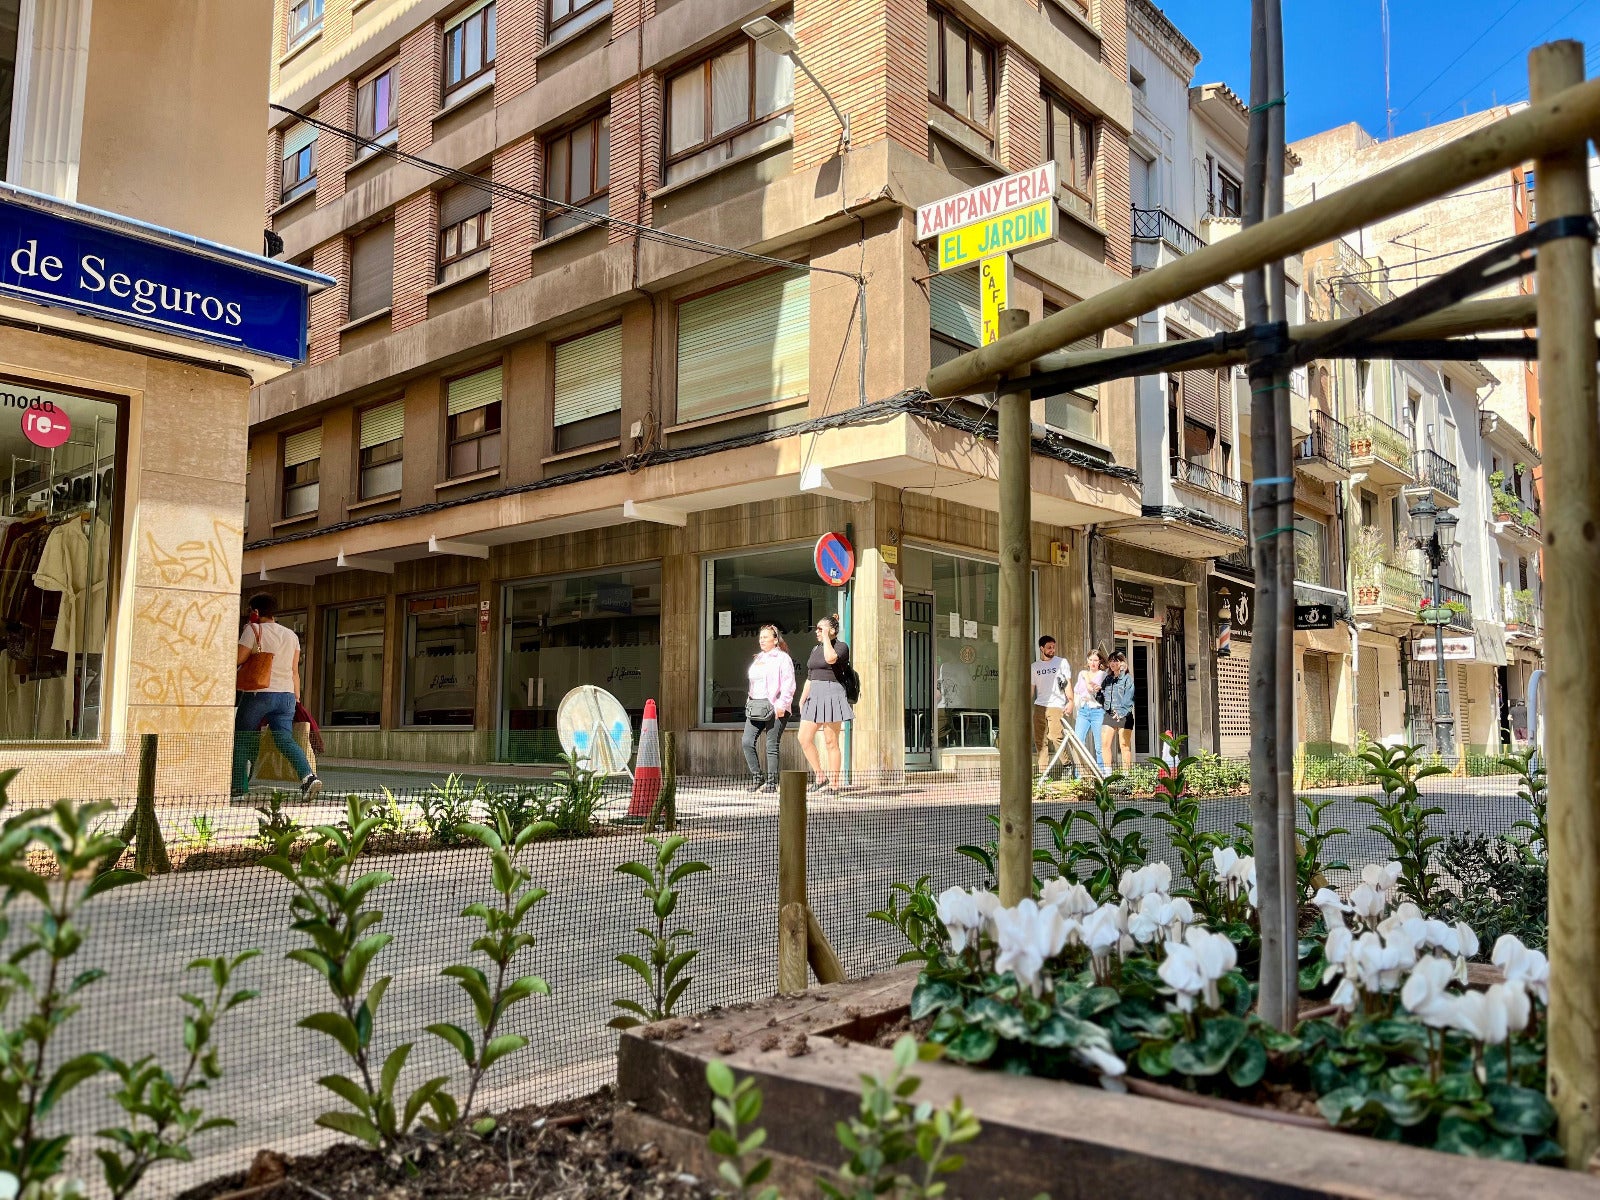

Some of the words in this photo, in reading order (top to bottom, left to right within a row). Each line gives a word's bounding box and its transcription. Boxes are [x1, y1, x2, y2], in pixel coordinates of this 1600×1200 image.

[921, 168, 1050, 235] XAMPANYERIA
[944, 234, 967, 264] EL
[978, 207, 1047, 252] JARDIN
[10, 240, 63, 282] de
[79, 255, 243, 325] Seguros
[982, 264, 1005, 313] CAFE
[0, 392, 56, 413] moda
